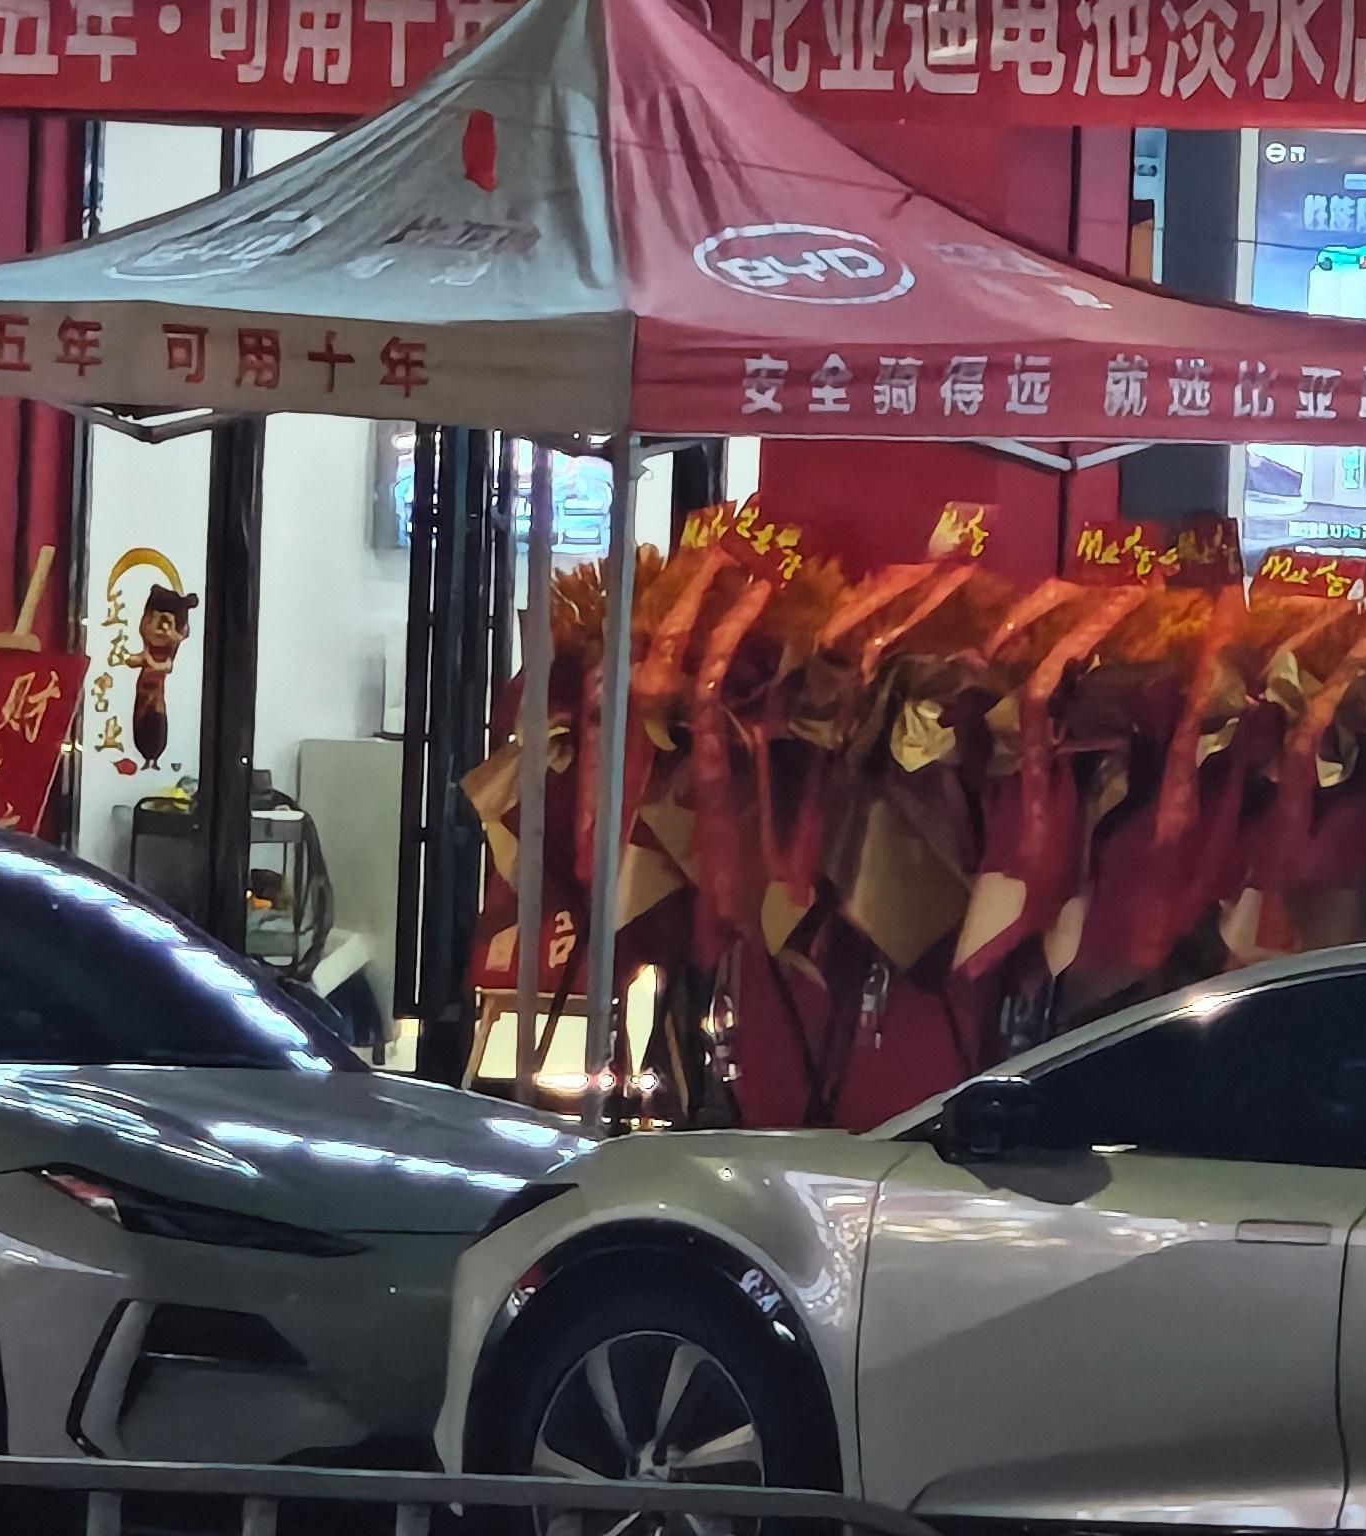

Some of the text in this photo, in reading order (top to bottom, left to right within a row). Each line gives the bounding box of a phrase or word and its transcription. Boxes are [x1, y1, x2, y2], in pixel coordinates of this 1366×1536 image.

[717, 247, 886, 288] BYD
[162, 322, 431, 400] 可用十年
[739, 353, 1053, 418] 安全骑得远
